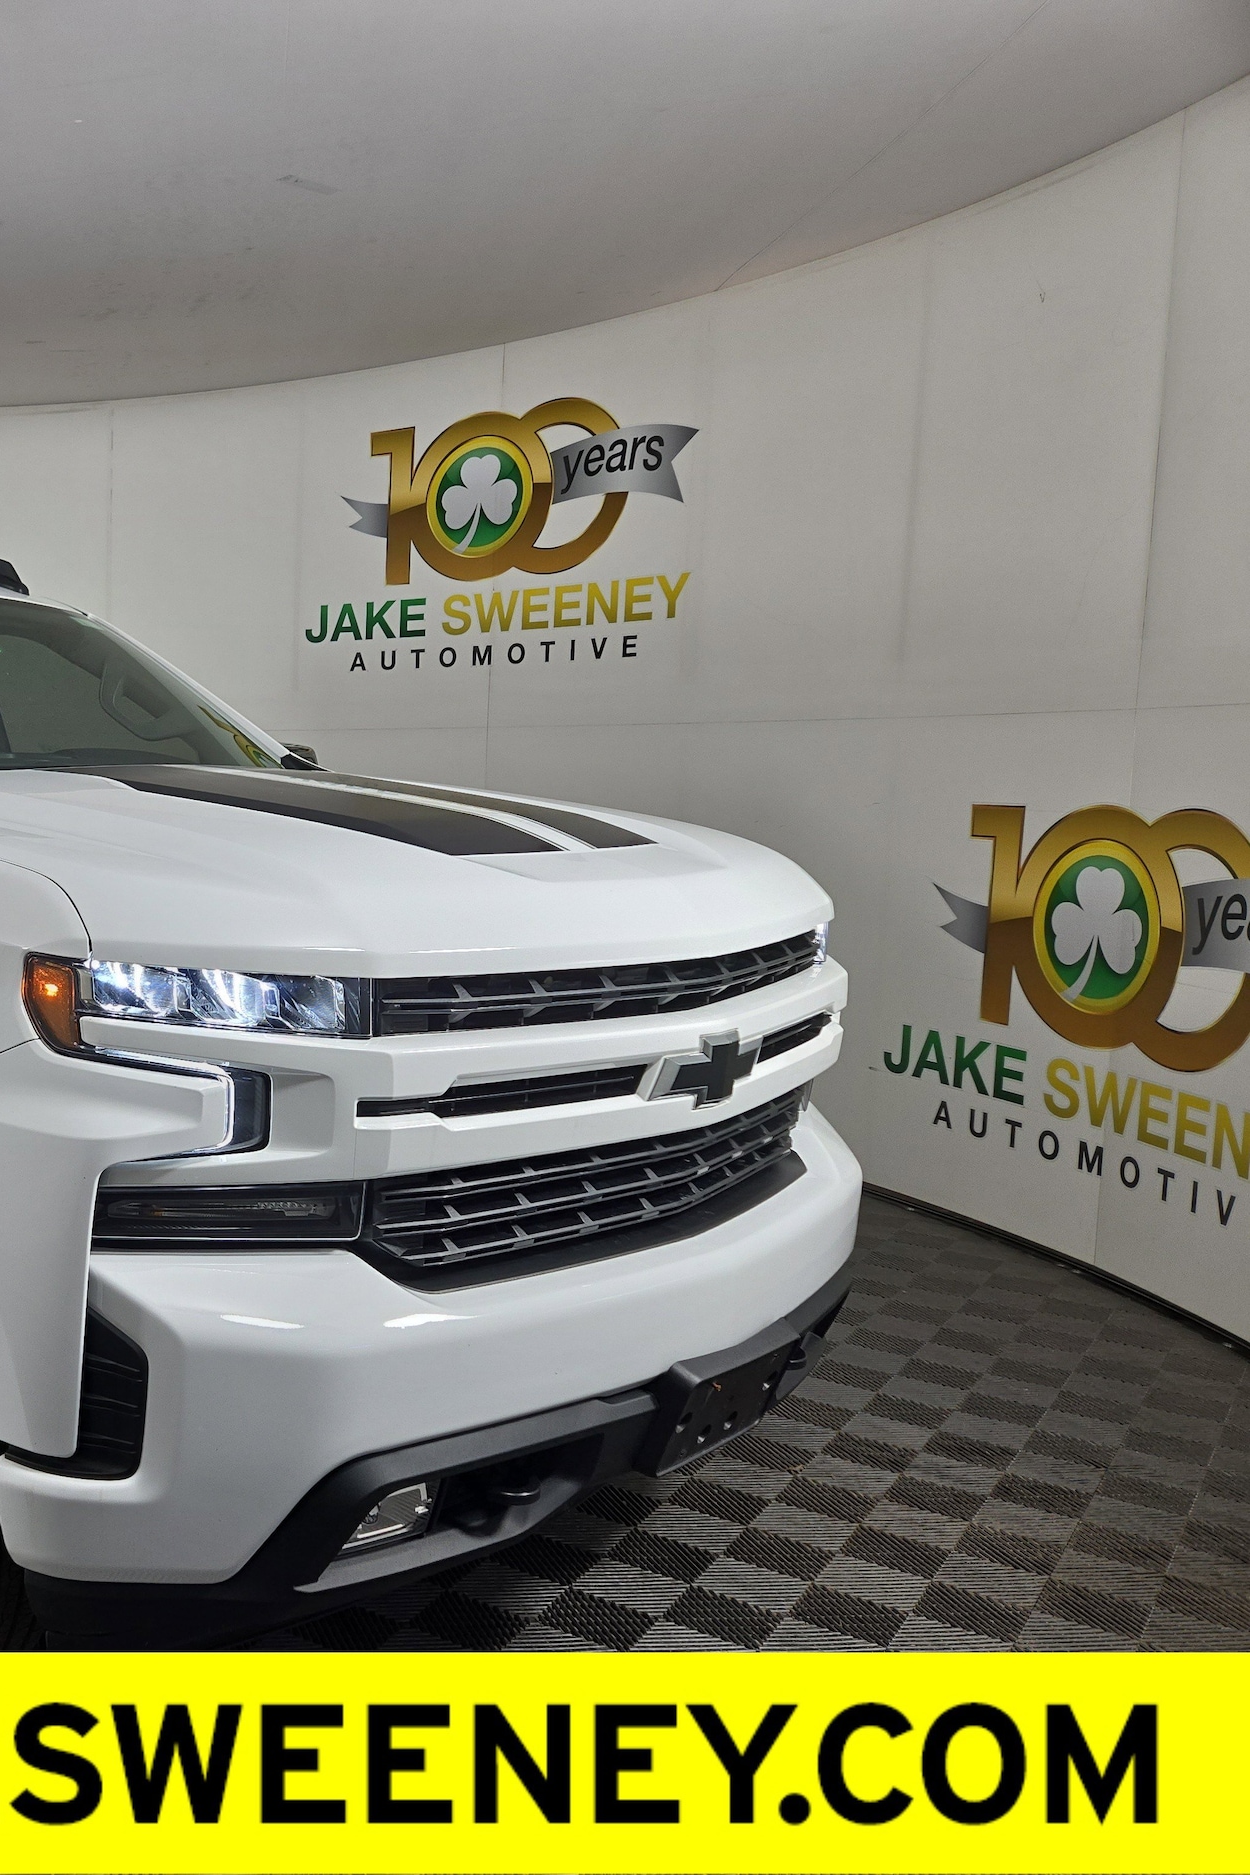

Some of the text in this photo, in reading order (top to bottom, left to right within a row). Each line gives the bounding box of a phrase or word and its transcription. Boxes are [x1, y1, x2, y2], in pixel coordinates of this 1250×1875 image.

[560, 434, 665, 494] years
[305, 572, 690, 643] JAKE SWEENEY
[350, 635, 638, 671] AUTOMOTIVE
[884, 1024, 1250, 1180] JAKE SWEEN
[933, 1101, 1236, 1226] AUTOMOTIV
